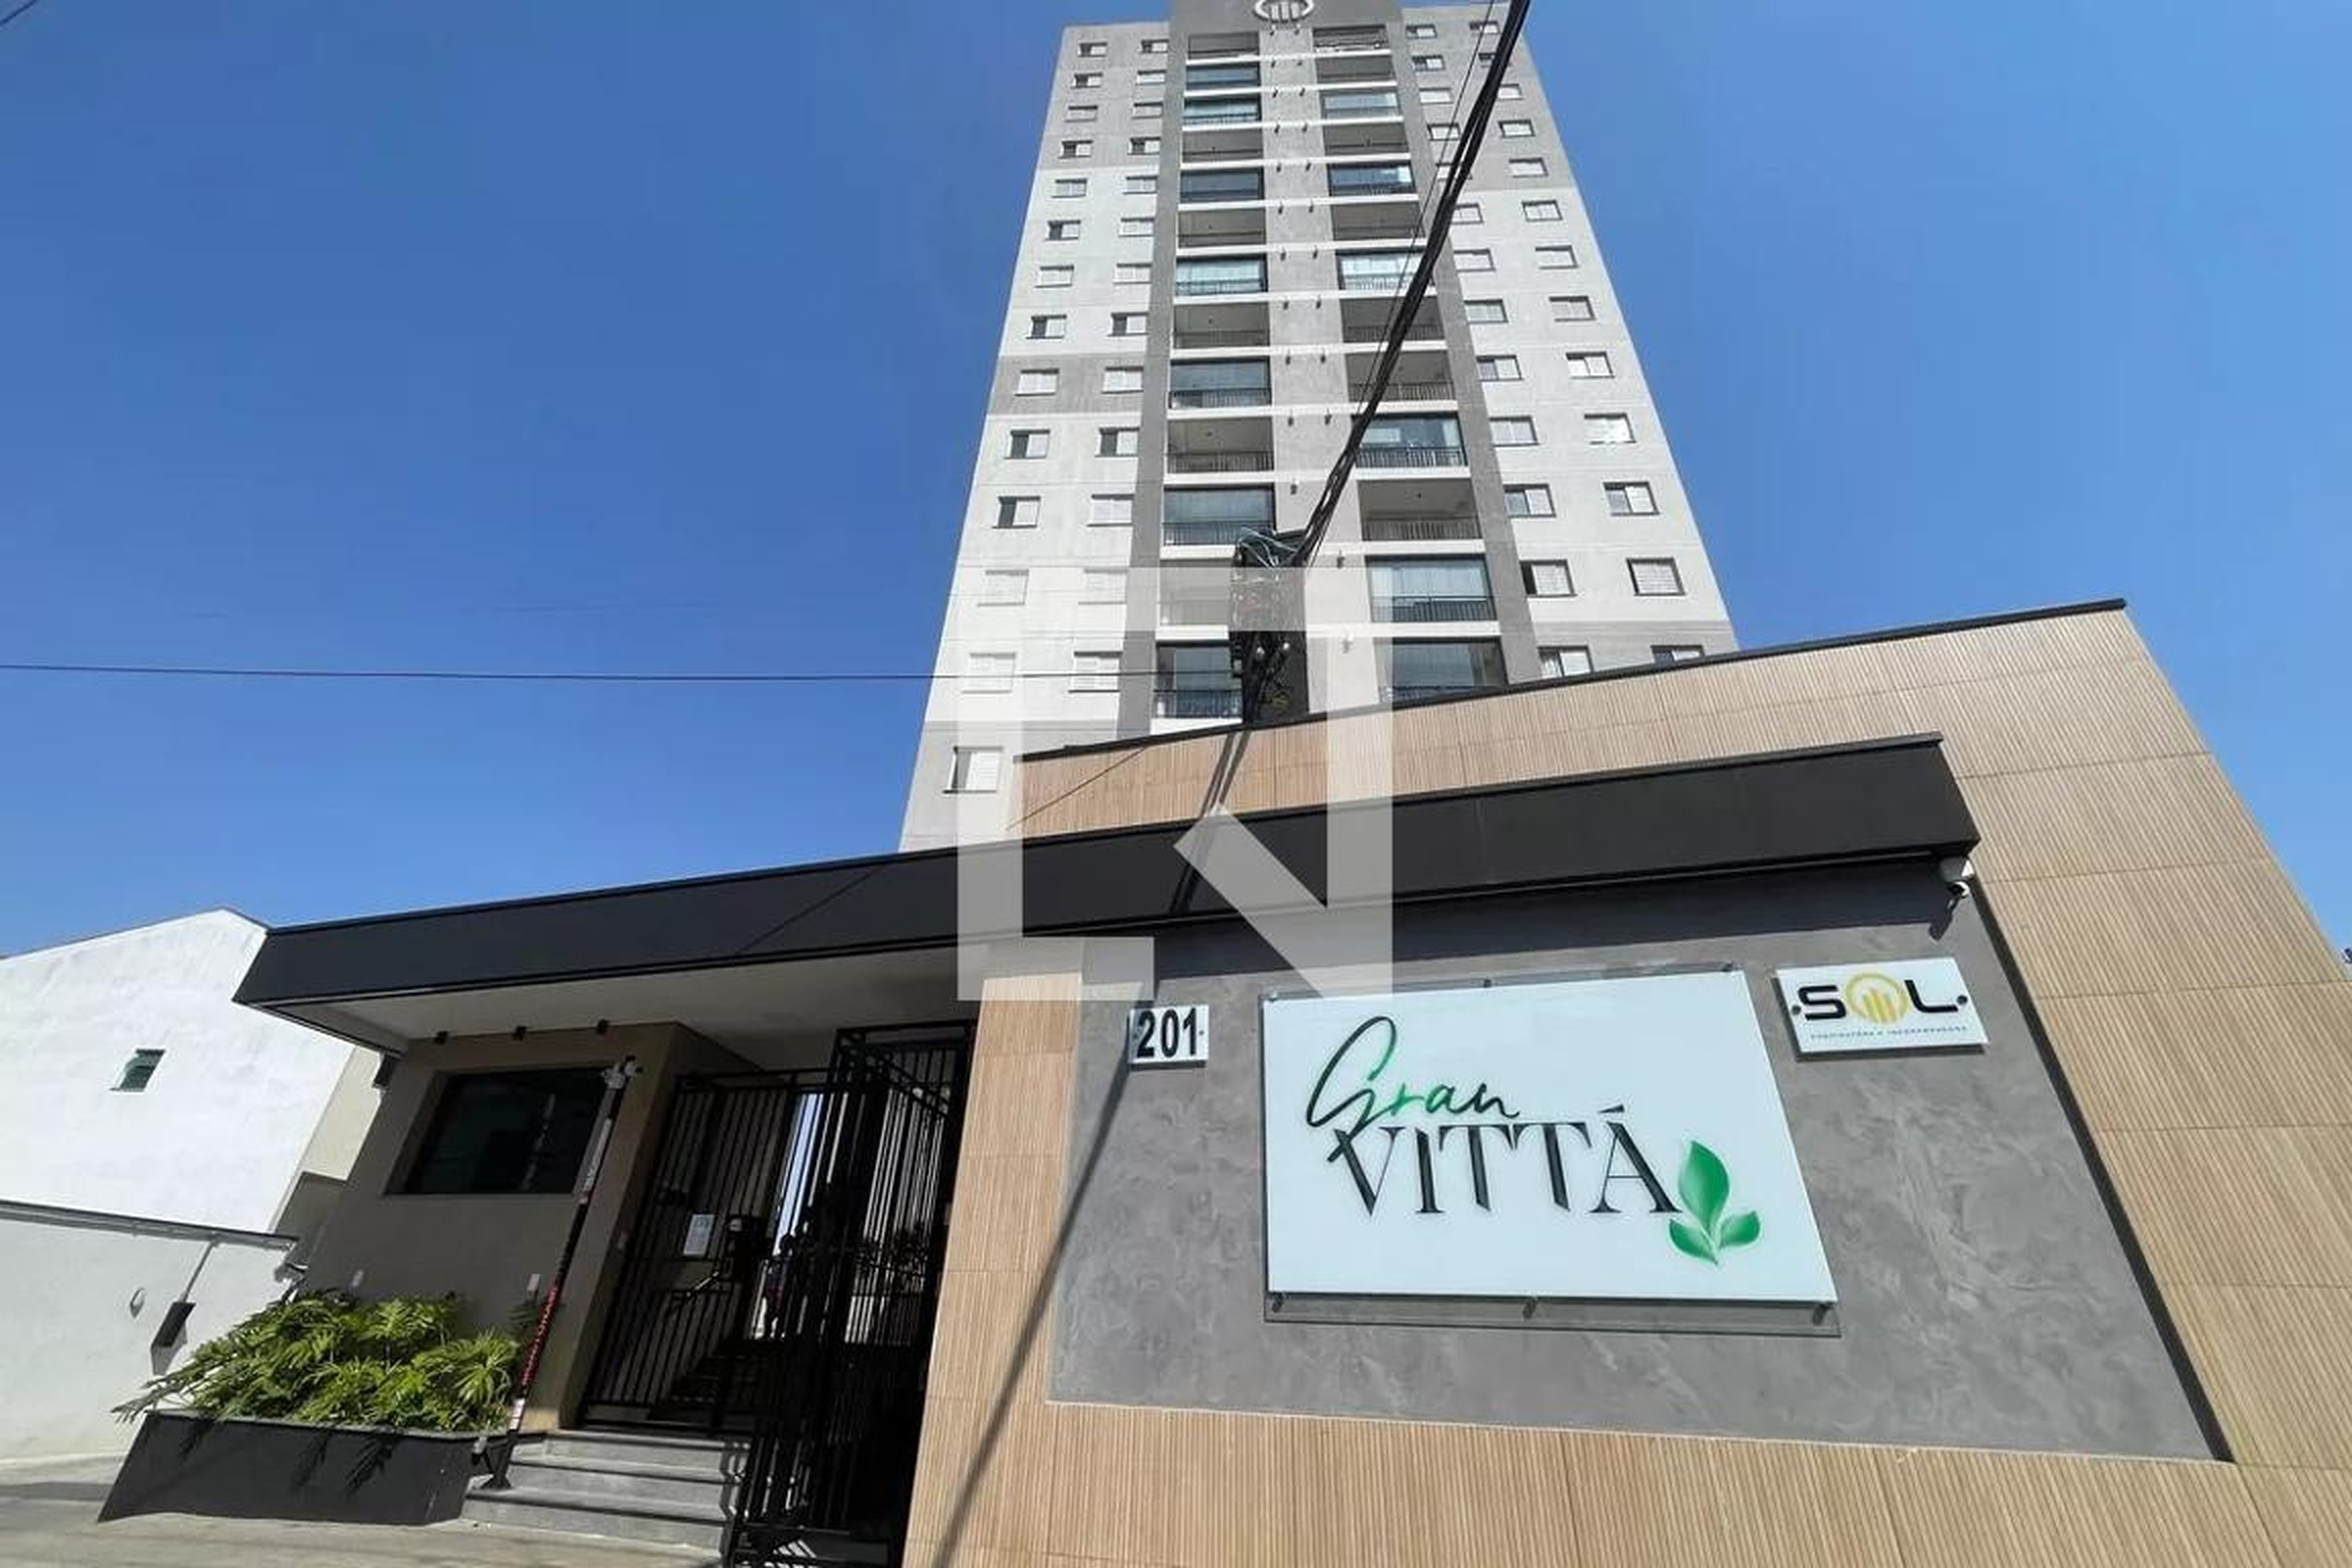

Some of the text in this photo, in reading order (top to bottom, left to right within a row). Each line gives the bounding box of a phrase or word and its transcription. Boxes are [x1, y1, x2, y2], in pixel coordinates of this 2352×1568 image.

[1136, 1007, 1196, 1058] 201
[1798, 972, 1959, 1024] SOL
[1306, 1015, 1521, 1163] Gran
[1334, 1104, 1683, 1216] VITTÁ
